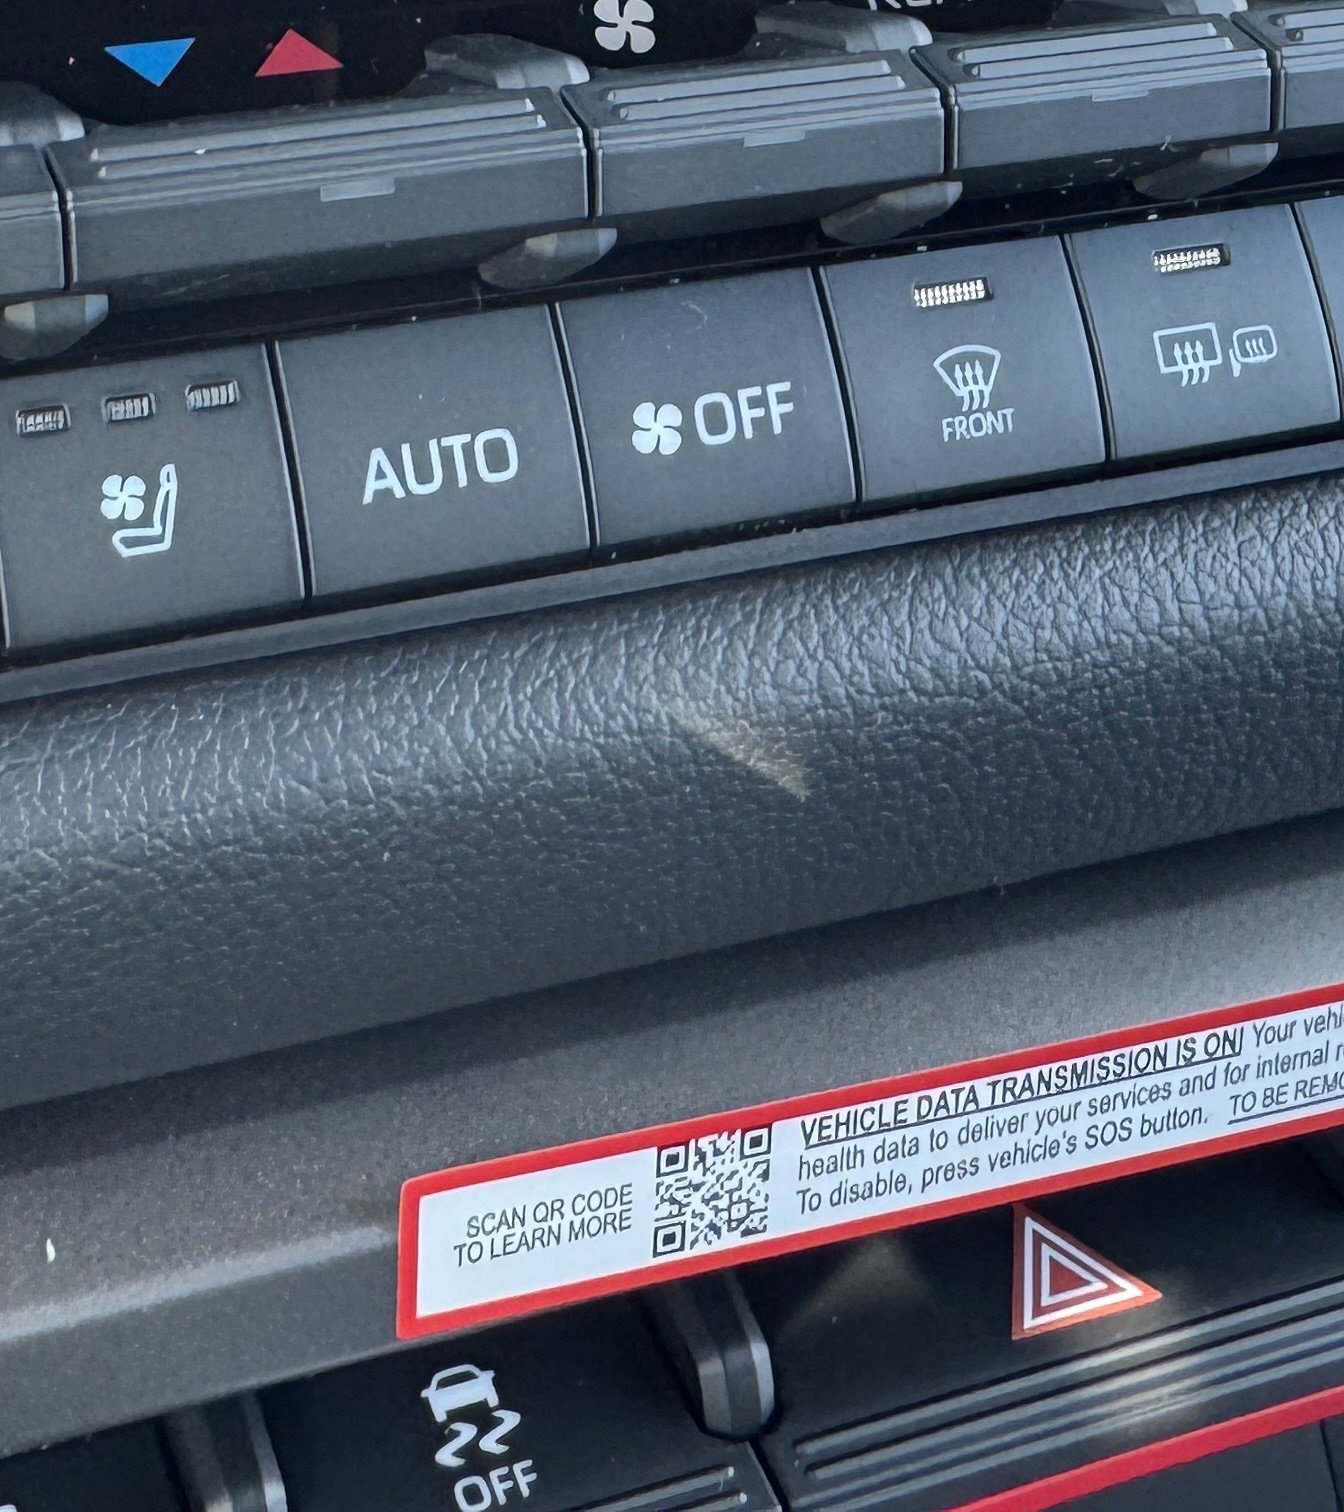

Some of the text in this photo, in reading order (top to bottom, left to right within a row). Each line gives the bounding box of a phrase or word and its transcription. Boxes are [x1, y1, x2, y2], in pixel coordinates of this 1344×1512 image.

[693, 381, 794, 449] OFF
[942, 407, 1015, 443] FRONT
[361, 427, 519, 505] AUTO
[798, 1142, 865, 1181] health
[873, 1136, 920, 1163] data
[930, 1127, 948, 1152] to
[957, 1112, 1028, 1147] deliver
[1034, 1100, 1082, 1135] your
[1087, 1080, 1172, 1118] services
[1178, 1064, 1217, 1096] and
[1223, 1061, 1251, 1087] for
[1256, 1039, 1329, 1079] internal
[801, 1098, 909, 1147] VEHICLE
[916, 1084, 979, 1120] DATA
[987, 1040, 1168, 1106] TRANSMISSION
[1176, 1036, 1196, 1064] IS
[1253, 1020, 1296, 1048] Your
[796, 1188, 821, 1215] To
[829, 1170, 913, 1208] disable,
[921, 1156, 979, 1194] press
[987, 1131, 1077, 1172] vehicle's
[1084, 1116, 1133, 1151] SOS
[1140, 1104, 1208, 1138] button.
[1230, 1091, 1257, 1116] TO
[1262, 1081, 1289, 1108] BE
[453, 1207, 633, 1268] TO LEARN MORE
[466, 1182, 633, 1239] SCAN QR CODE
[453, 1458, 538, 1512] OFF
